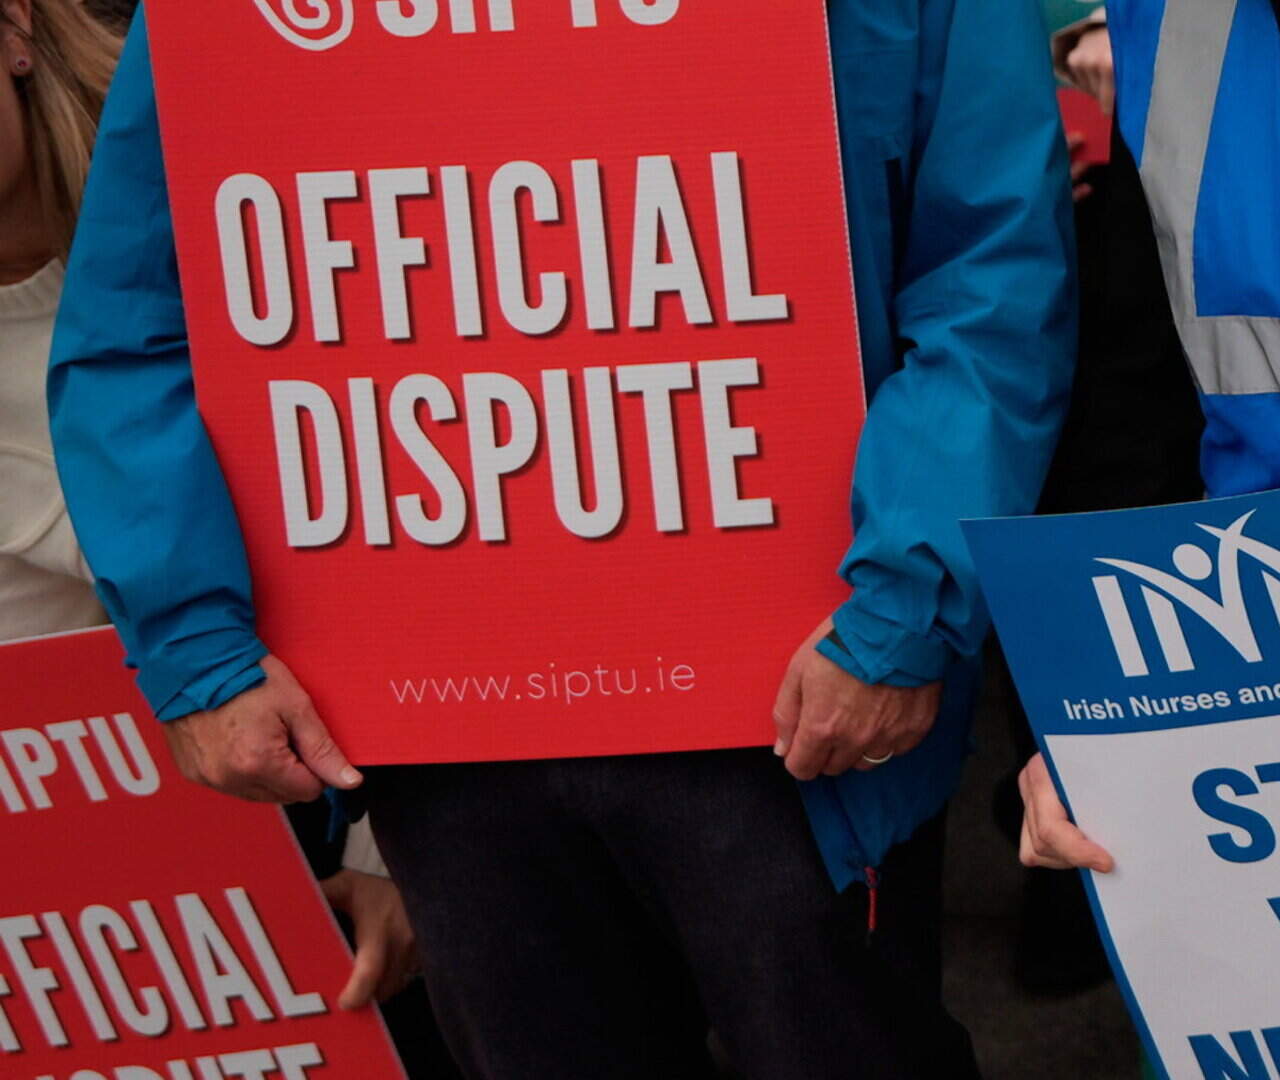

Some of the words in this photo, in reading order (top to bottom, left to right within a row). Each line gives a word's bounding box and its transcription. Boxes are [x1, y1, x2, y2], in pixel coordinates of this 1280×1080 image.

[214, 151, 790, 347] OFFICIAL
[268, 357, 775, 548] DISPUTE
[390, 657, 697, 706] www.siptu.ie
[1063, 698, 1125, 721] Irish
[1132, 687, 1232, 718] Nurses
[0, 712, 161, 813] IPTU
[0, 886, 328, 1053] FICIAL
